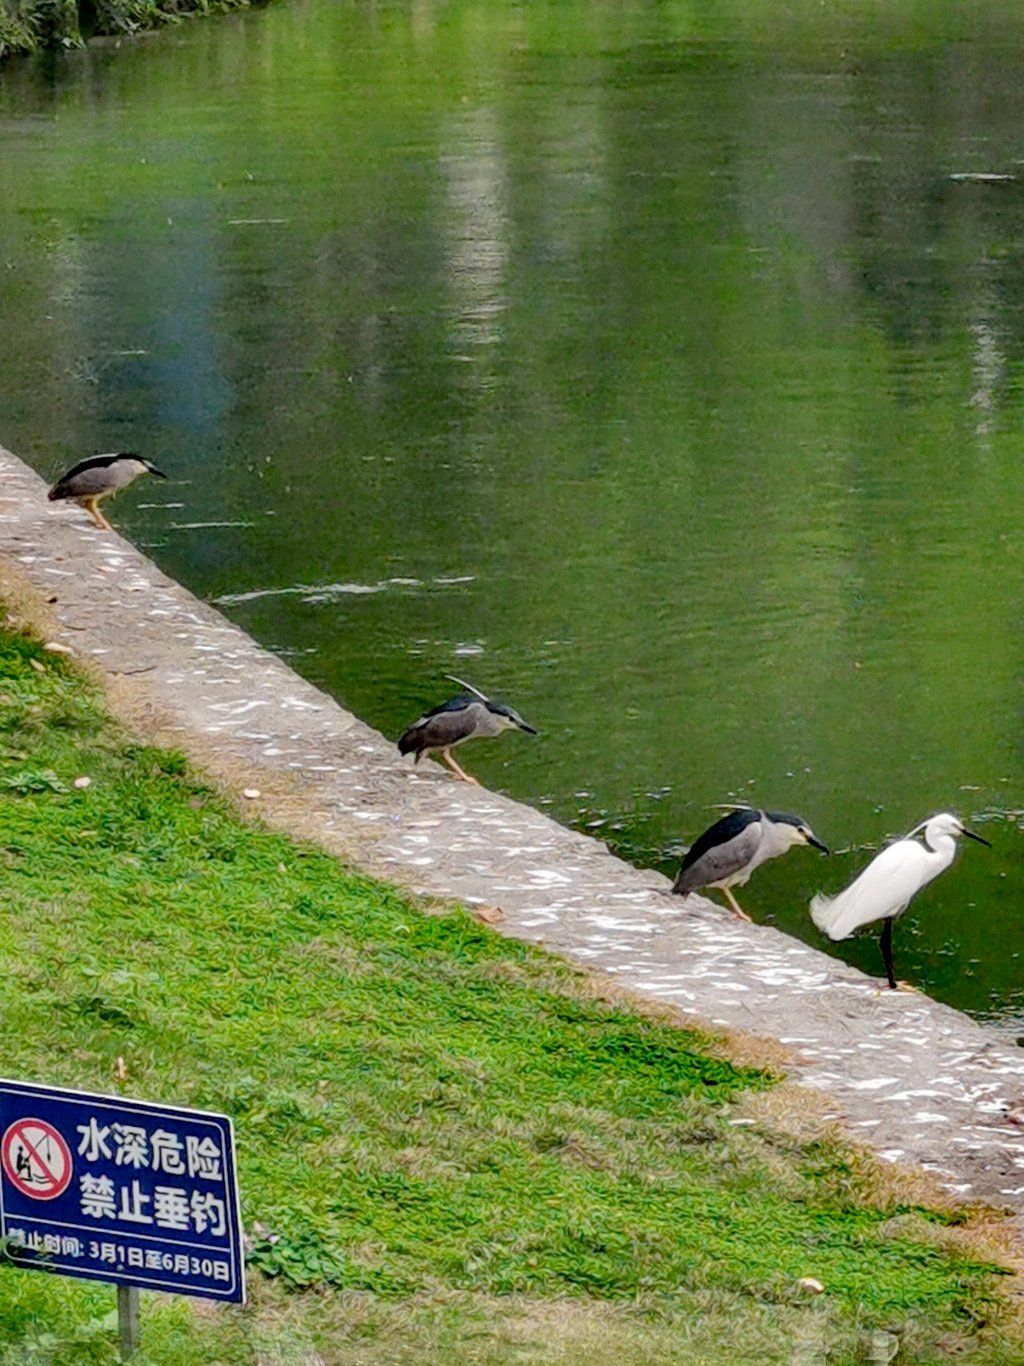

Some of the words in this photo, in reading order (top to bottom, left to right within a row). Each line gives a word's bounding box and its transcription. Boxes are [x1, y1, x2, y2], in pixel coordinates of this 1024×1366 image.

[76, 1117, 223, 1181] 水深危险
[80, 1172, 226, 1236] 禁止垂钓
